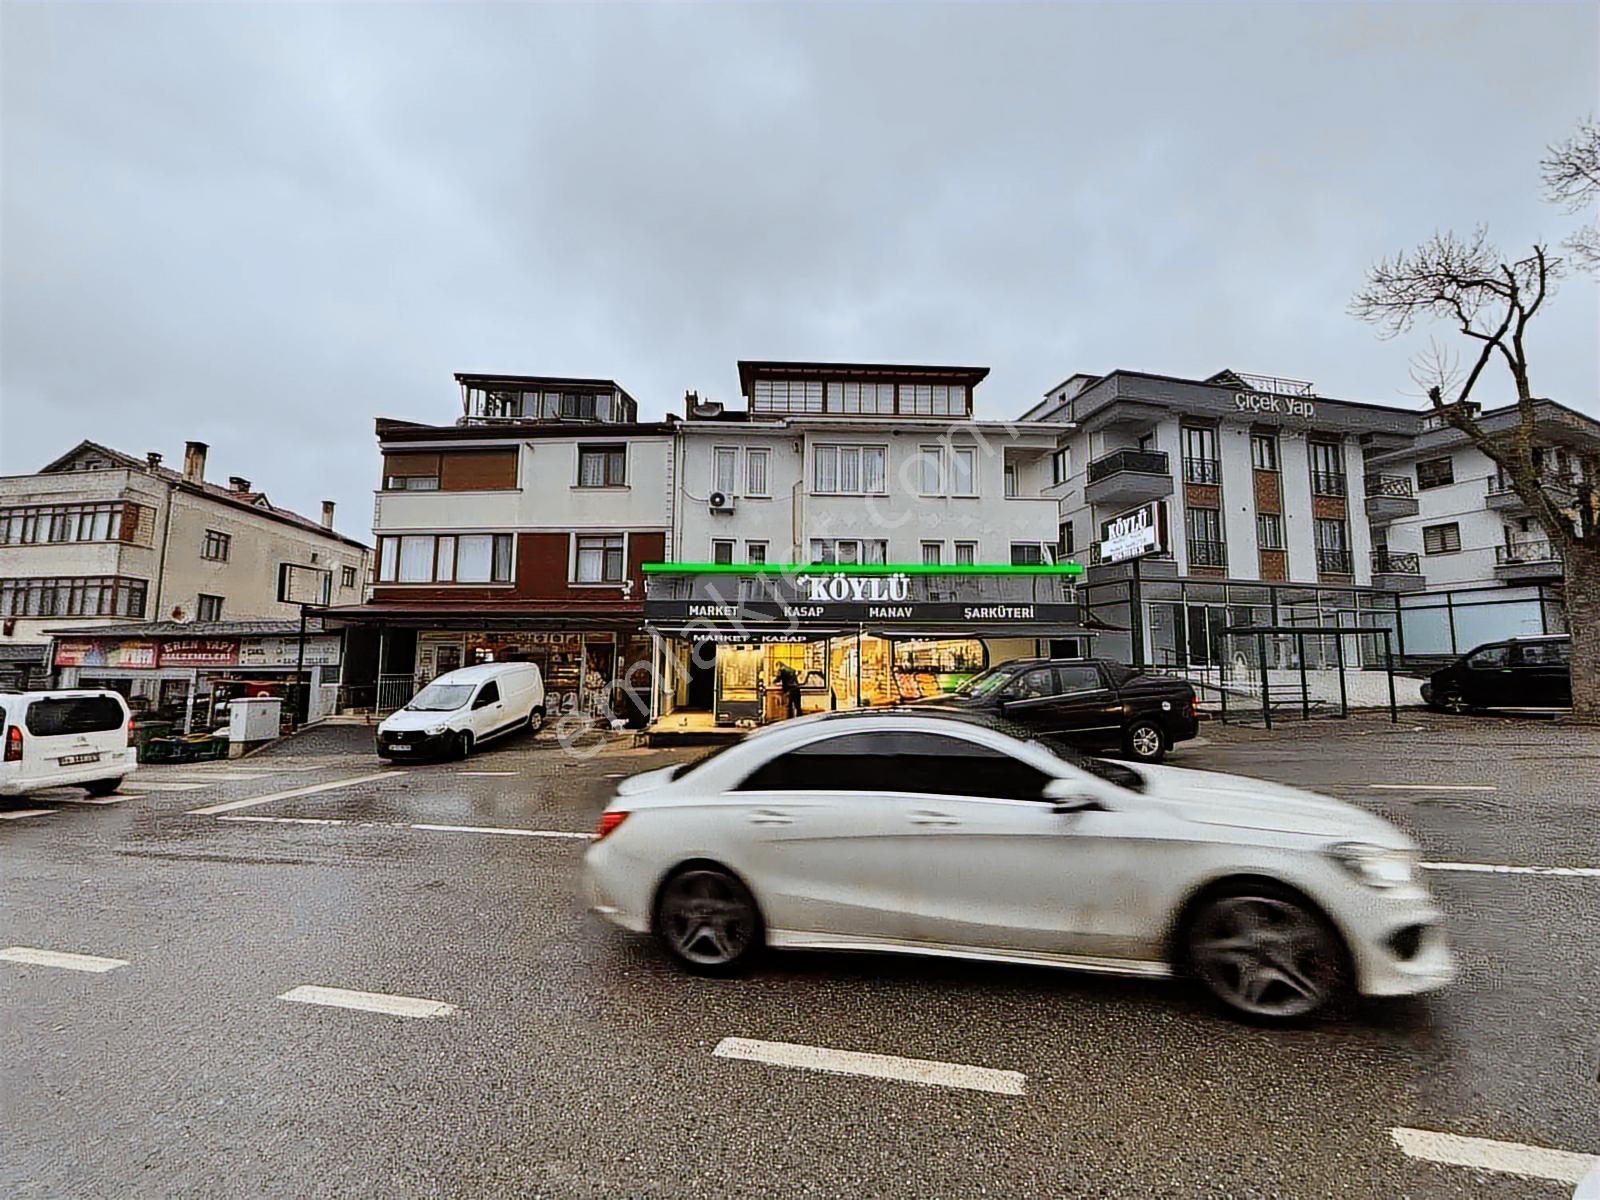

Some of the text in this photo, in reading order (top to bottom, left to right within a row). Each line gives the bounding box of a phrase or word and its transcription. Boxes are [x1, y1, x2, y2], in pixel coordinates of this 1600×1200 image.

[808, 573, 910, 601] KÖYLÜ
[689, 605, 1034, 620] MARKET KASAP MANAV ŞARKÜTERİ
[692, 634, 749, 643] MARKET
[761, 635, 807, 643] KASAP
